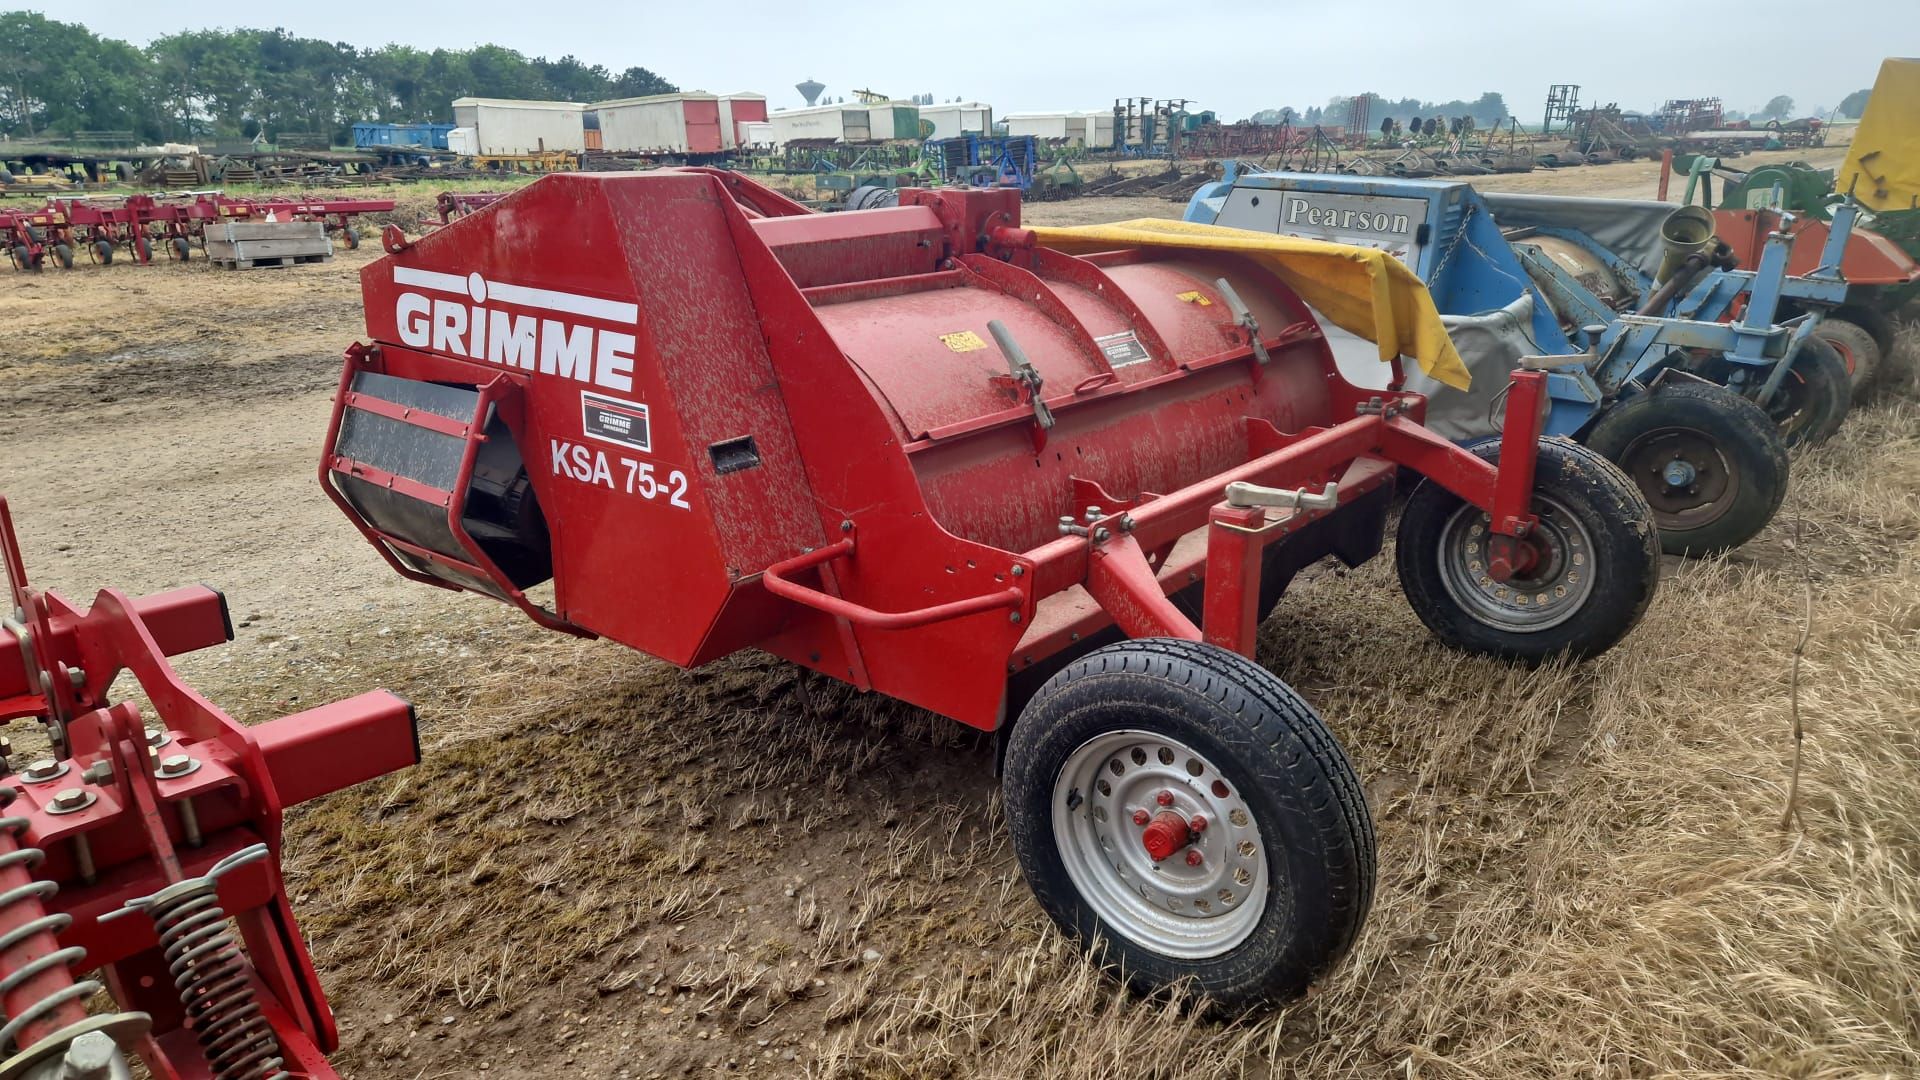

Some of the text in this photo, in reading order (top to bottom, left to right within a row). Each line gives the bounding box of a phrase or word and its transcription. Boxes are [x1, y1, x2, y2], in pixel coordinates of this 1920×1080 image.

[1286, 198, 1410, 234] Pearson
[395, 272, 636, 392] GRIMME
[599, 413, 631, 429] GRIMME
[550, 438, 690, 511] KSA 75-2
